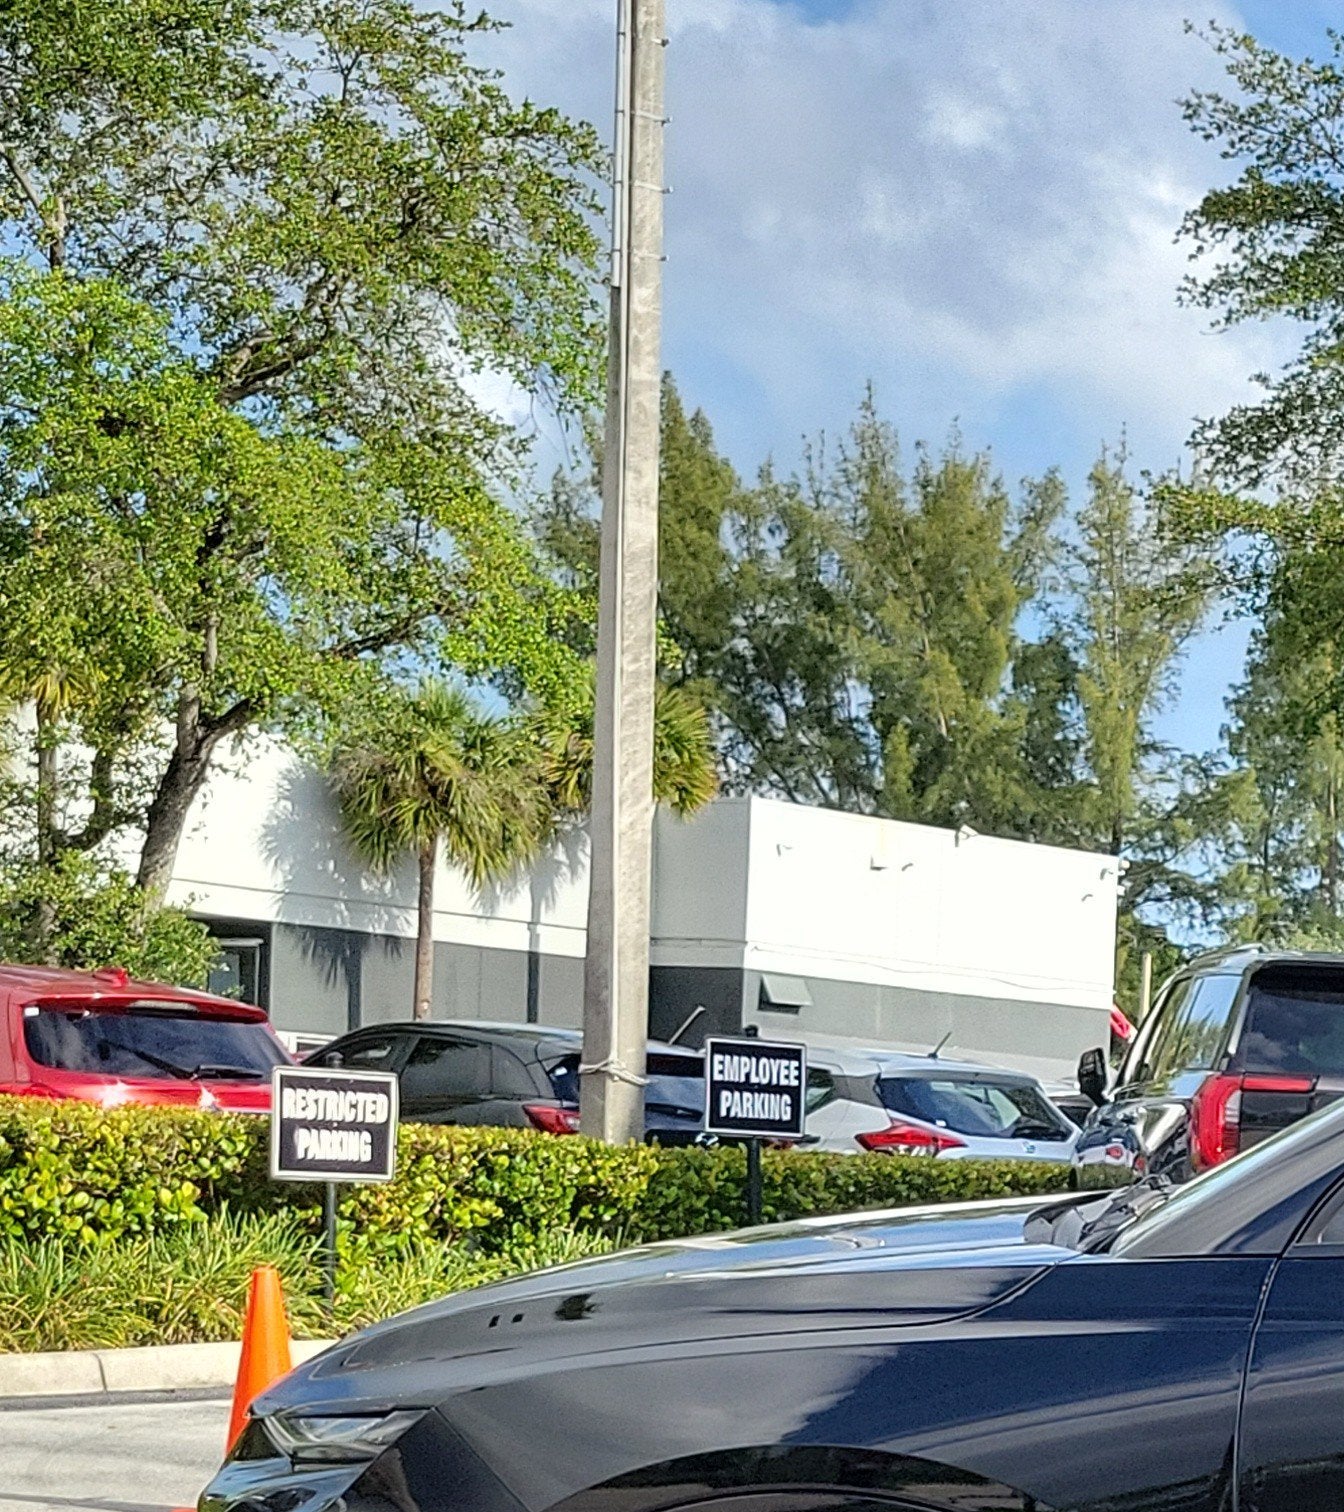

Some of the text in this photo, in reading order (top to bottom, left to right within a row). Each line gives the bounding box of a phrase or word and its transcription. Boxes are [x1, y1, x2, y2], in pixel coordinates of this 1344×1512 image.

[713, 1053, 799, 1087] EMPLOYEE
[281, 1086, 389, 1124] RESTRICTED
[720, 1089, 792, 1122] PARKING
[295, 1126, 372, 1163] PARKING
